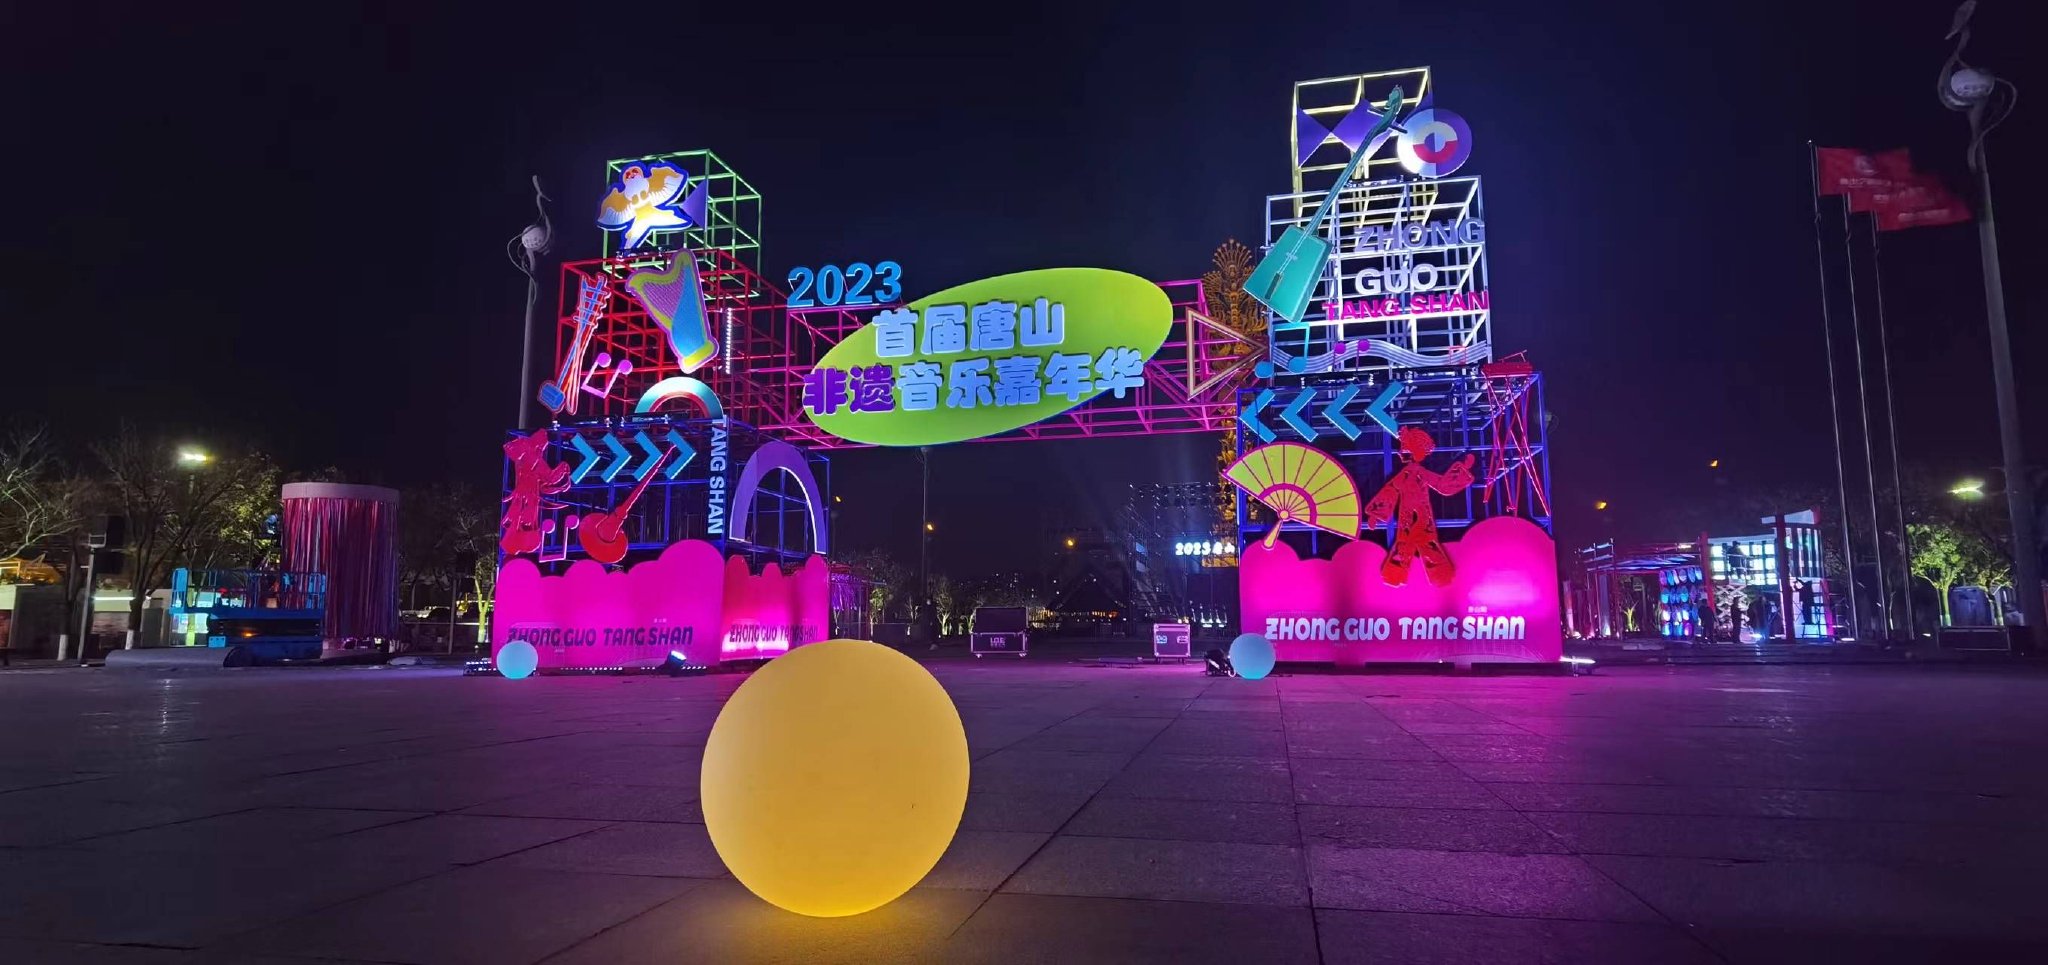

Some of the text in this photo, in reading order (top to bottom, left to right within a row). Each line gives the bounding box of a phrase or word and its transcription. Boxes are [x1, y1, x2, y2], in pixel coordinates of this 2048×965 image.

[1353, 218, 1484, 252] ZHONG
[787, 261, 902, 307] 2023
[1354, 263, 1438, 295] GUO
[1322, 290, 1489, 321] TANG SHAN
[872, 297, 1065, 358] 首届唐山
[802, 346, 1145, 415] 非遗音乐嘉年华
[707, 415, 727, 534] TANG SHAN
[507, 626, 693, 647] ZHONG GUO TANG SHAN
[1264, 615, 1525, 641] ZHONG GUO TANG SHAN
